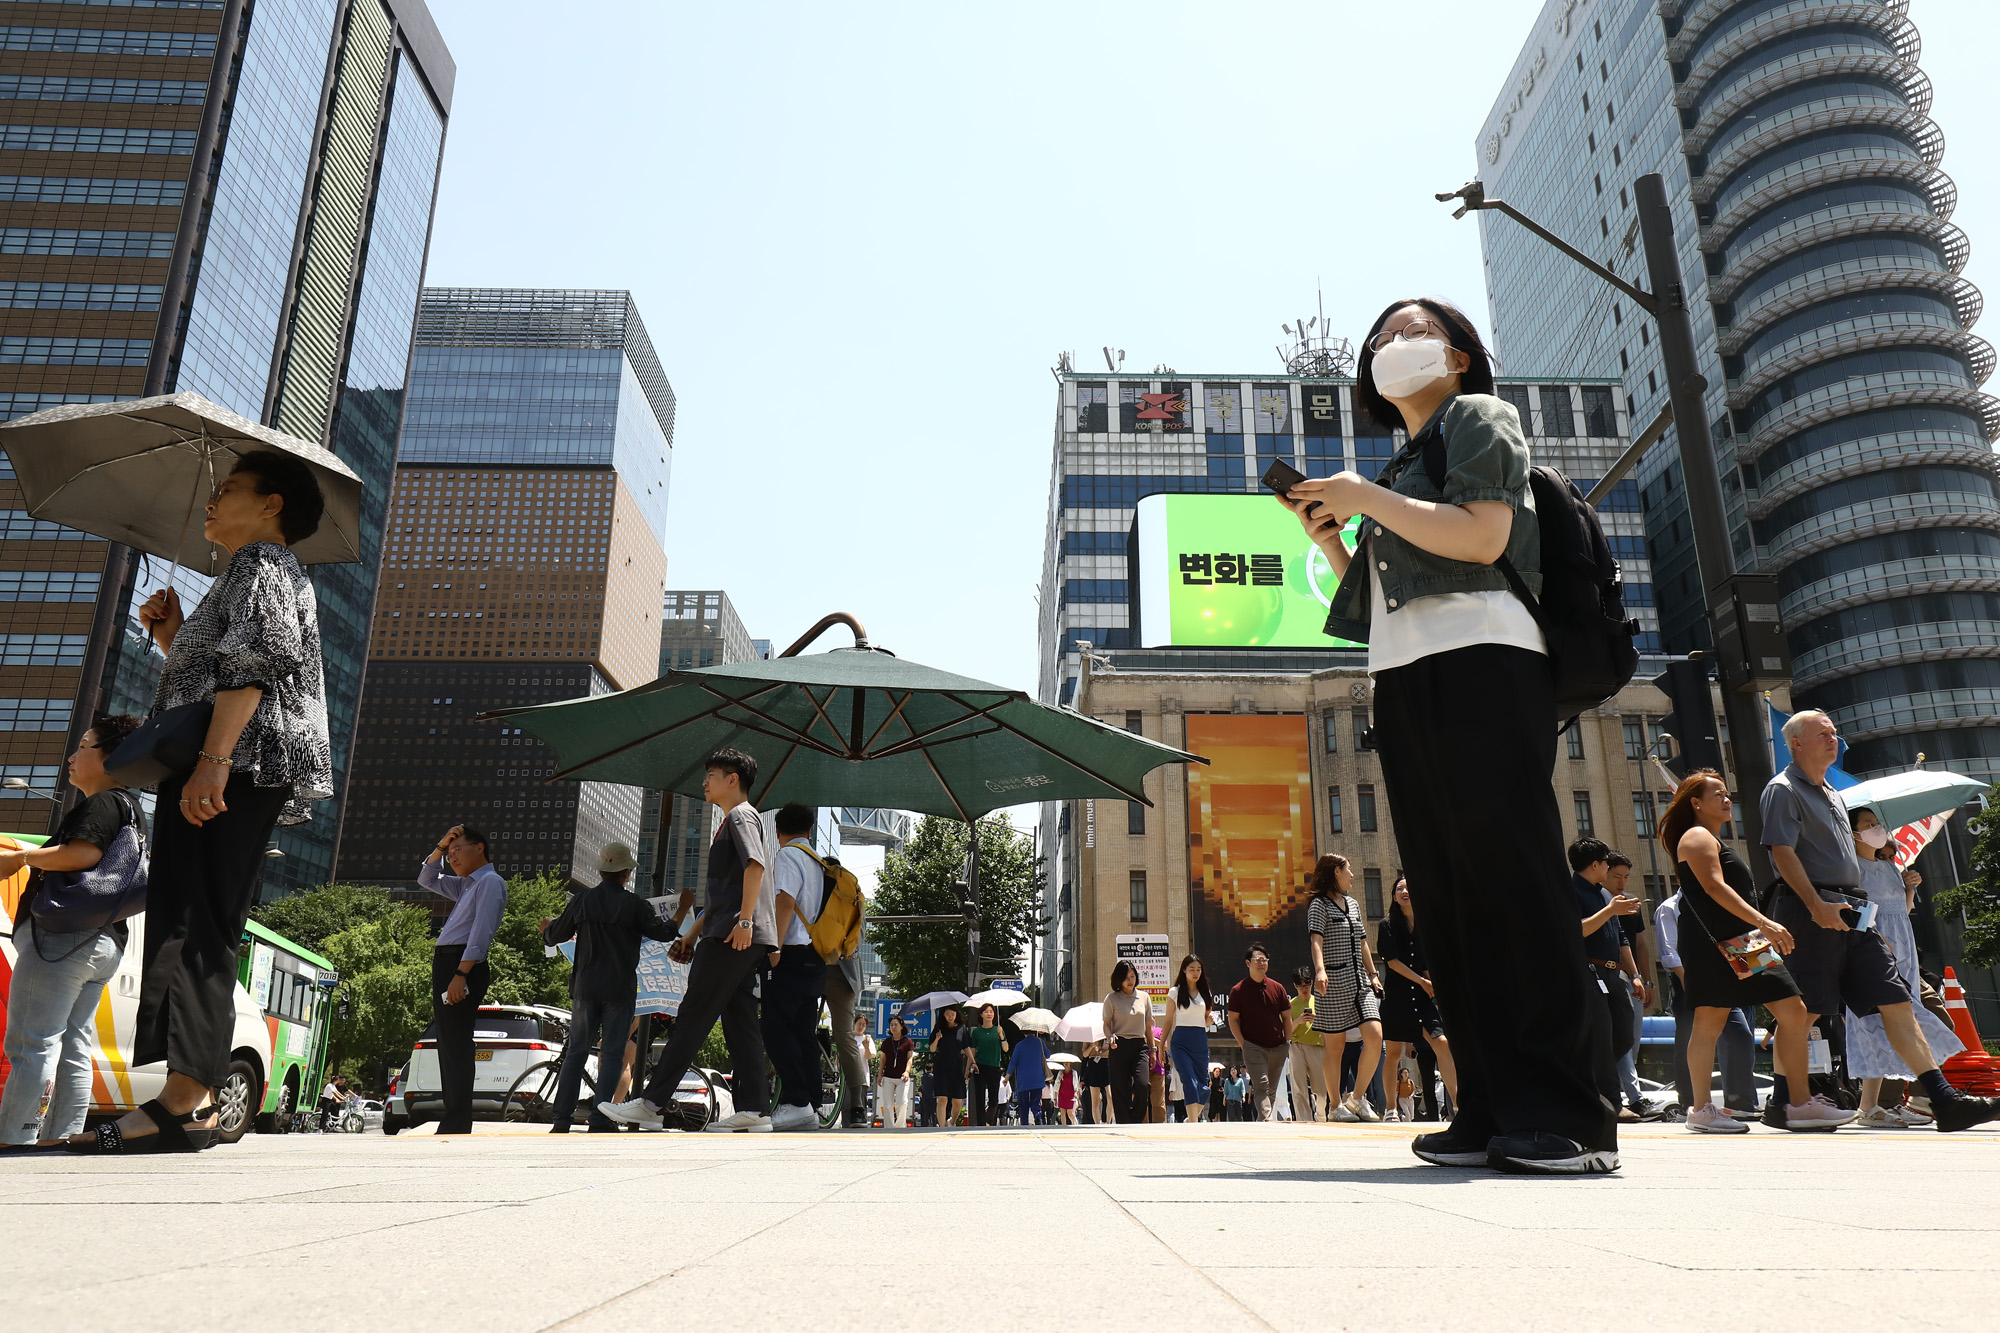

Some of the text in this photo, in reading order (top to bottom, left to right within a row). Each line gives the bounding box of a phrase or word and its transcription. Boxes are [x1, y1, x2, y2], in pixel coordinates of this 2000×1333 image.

[1165, 422, 1187, 430] POST
[1179, 553, 1284, 586] 변화를
[1085, 824, 1094, 848] ilmin
[319, 971, 338, 981] 7018
